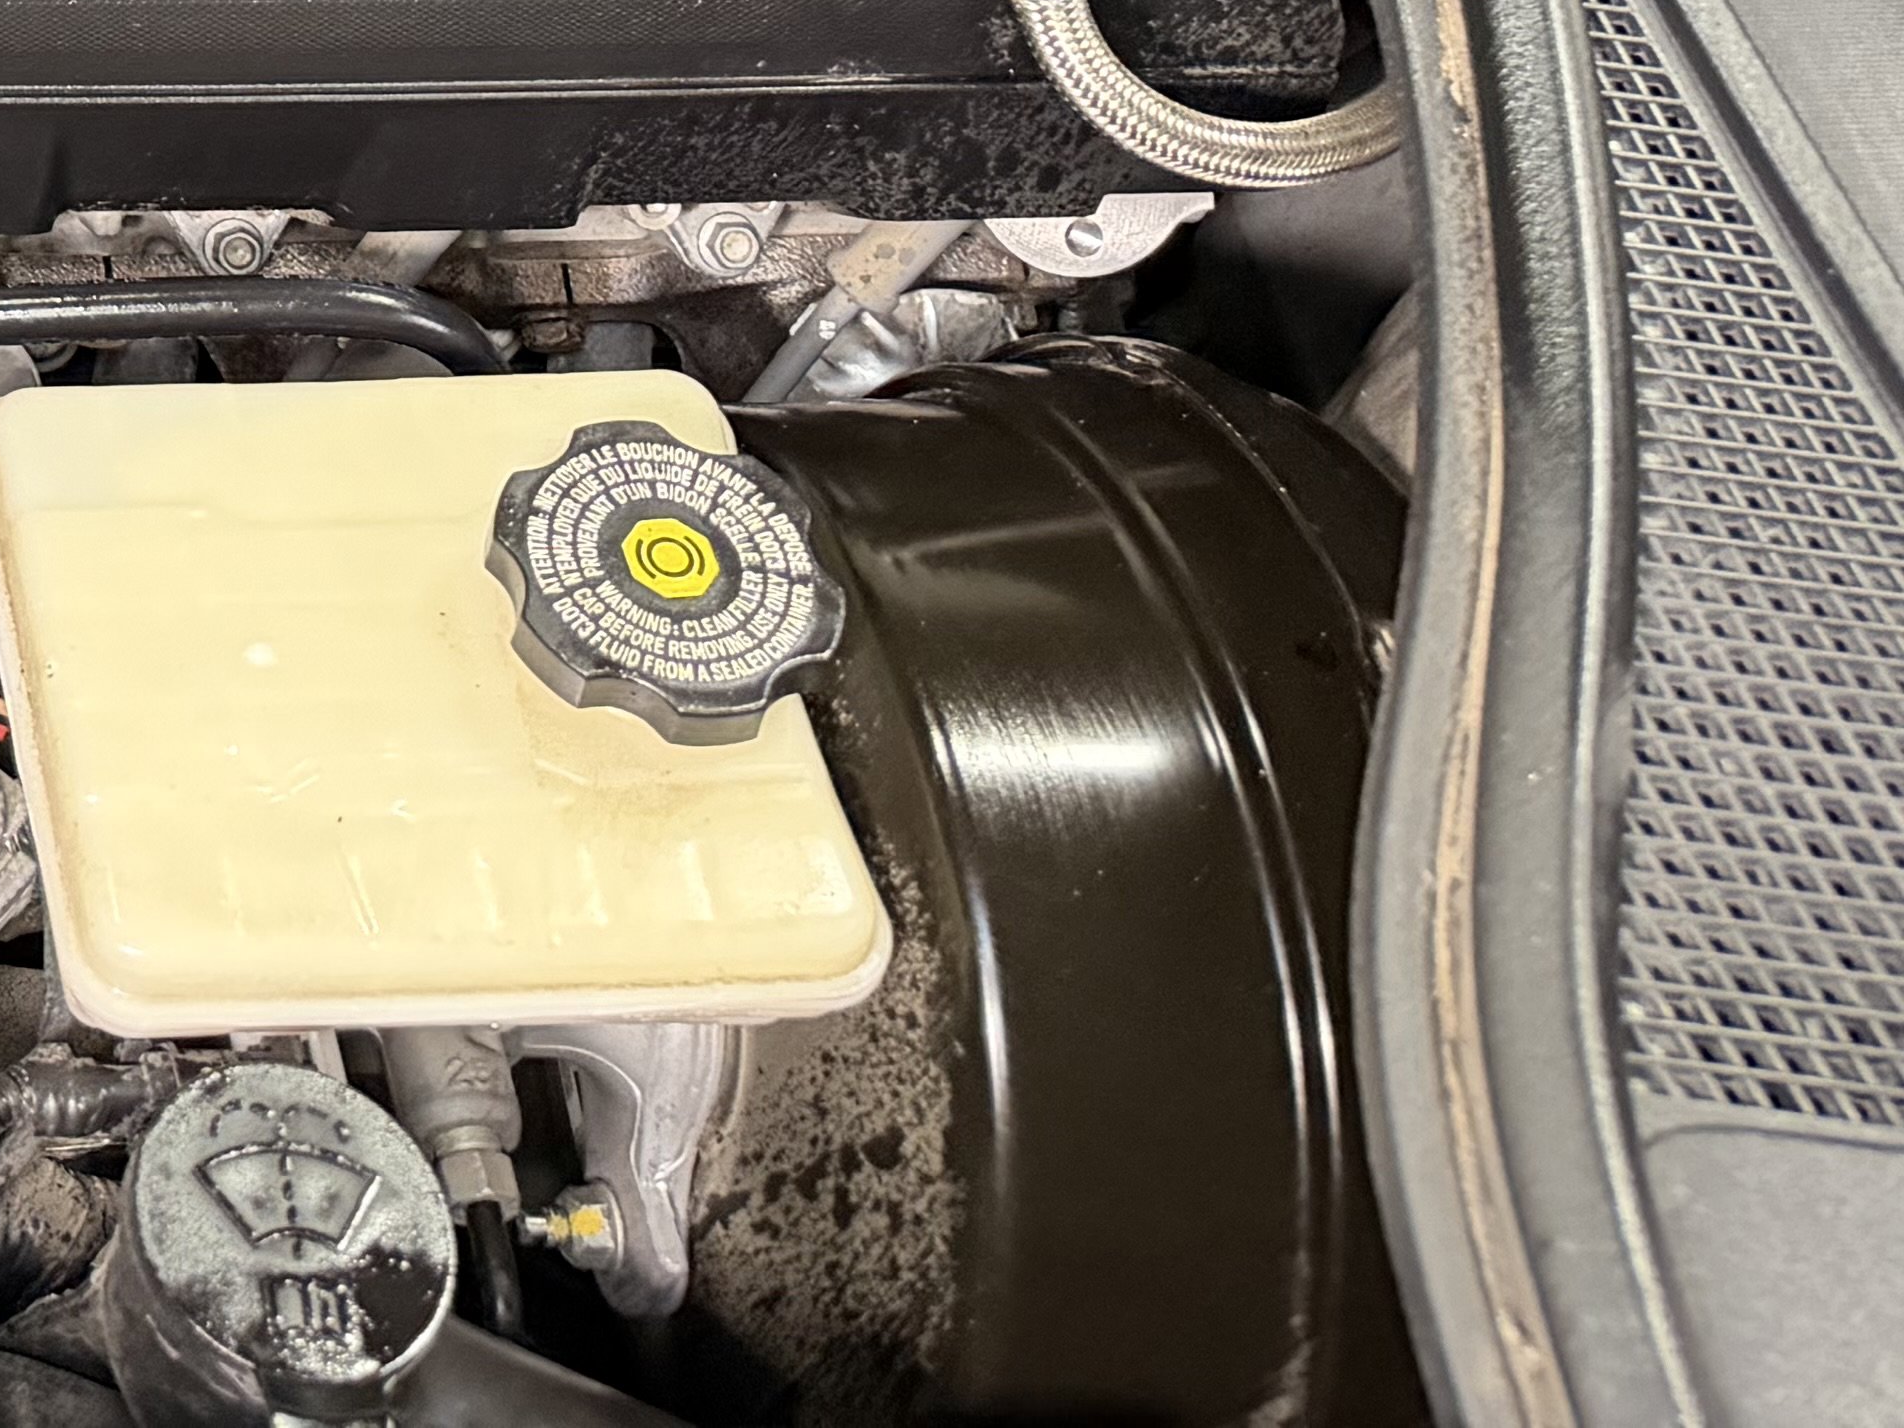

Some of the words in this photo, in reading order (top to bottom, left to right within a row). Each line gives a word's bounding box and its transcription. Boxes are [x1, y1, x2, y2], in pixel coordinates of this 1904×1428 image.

[532, 453, 596, 514] NETTOYER
[594, 445, 618, 466] LE
[616, 442, 699, 469] BOUCHON
[699, 458, 757, 499] AVANT
[572, 474, 605, 503] QUE
[599, 465, 624, 485] DU
[628, 463, 692, 486] LIQUIDE
[694, 474, 720, 496] DE
[718, 490, 766, 533] FREIN
[754, 532, 786, 572] DOT3
[576, 496, 615, 579] PROVENANT
[616, 483, 652, 504] D'UN
[656, 483, 712, 516] BIDON
[750, 493, 776, 517] LA
[527, 514, 564, 594] ATTENTION:
[553, 596, 594, 638] DOT3
[588, 632, 641, 667] FLUID
[643, 655, 693, 682] FROM
[698, 664, 711, 682] A
[711, 648, 771, 682] SEALED
[764, 583, 814, 660] CONTAINER.
[573, 588, 605, 621] CAP
[600, 614, 665, 655] BEFORE
[668, 630, 758, 660] REMOVING.
[747, 608, 780, 640] USE
[766, 574, 789, 614] ONLY
[682, 604, 741, 638] CLEAN
[732, 571, 763, 622] FILLER
